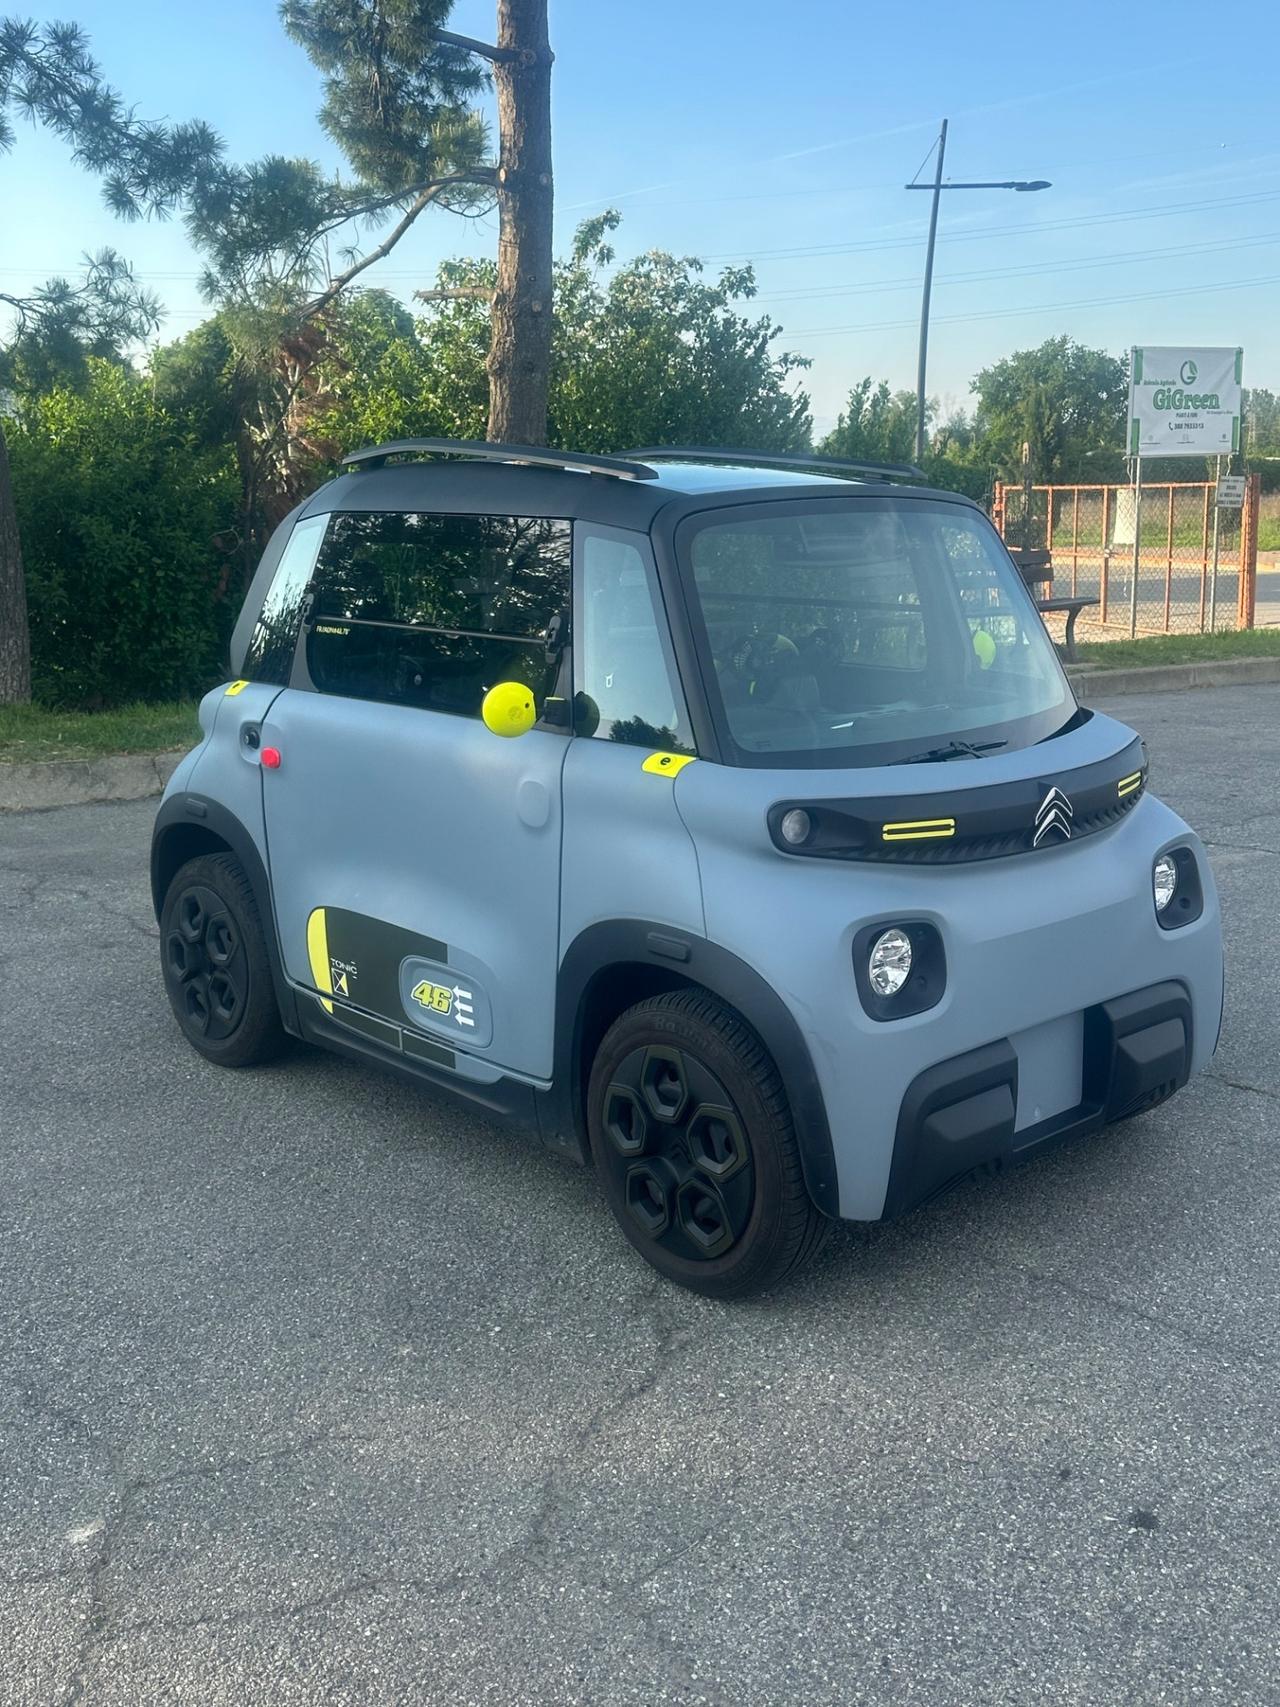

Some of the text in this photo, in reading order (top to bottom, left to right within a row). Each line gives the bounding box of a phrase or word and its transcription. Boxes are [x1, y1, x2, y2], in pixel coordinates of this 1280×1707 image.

[1152, 387, 1220, 411] GiGreen
[330, 957, 358, 975] TONIC
[410, 979, 453, 1016] 46
